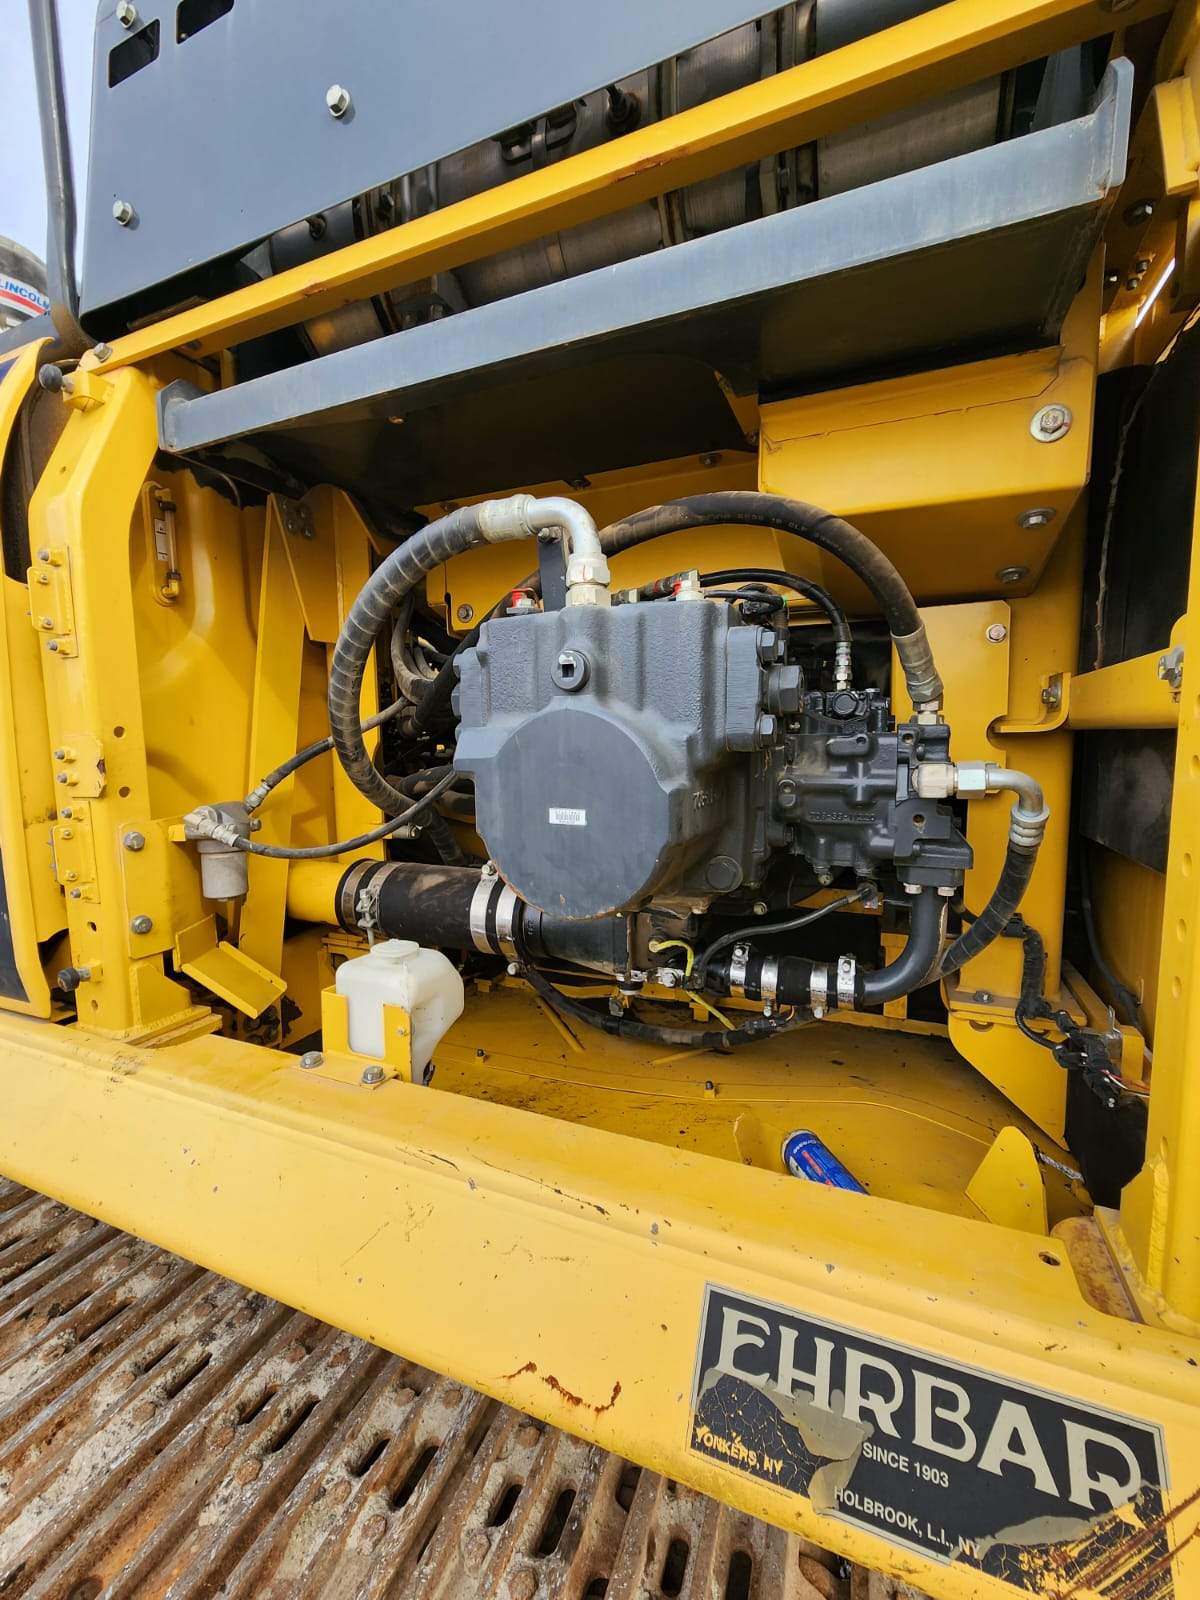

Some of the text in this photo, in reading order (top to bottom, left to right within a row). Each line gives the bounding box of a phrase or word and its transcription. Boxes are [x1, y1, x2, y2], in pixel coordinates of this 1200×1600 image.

[718, 1305, 1142, 1511] EHRBAR
[764, 1454, 784, 1476] NY
[862, 1442, 949, 1488] SINCE 1903
[834, 1486, 980, 1559] HOLBROOK, L.I., NY
